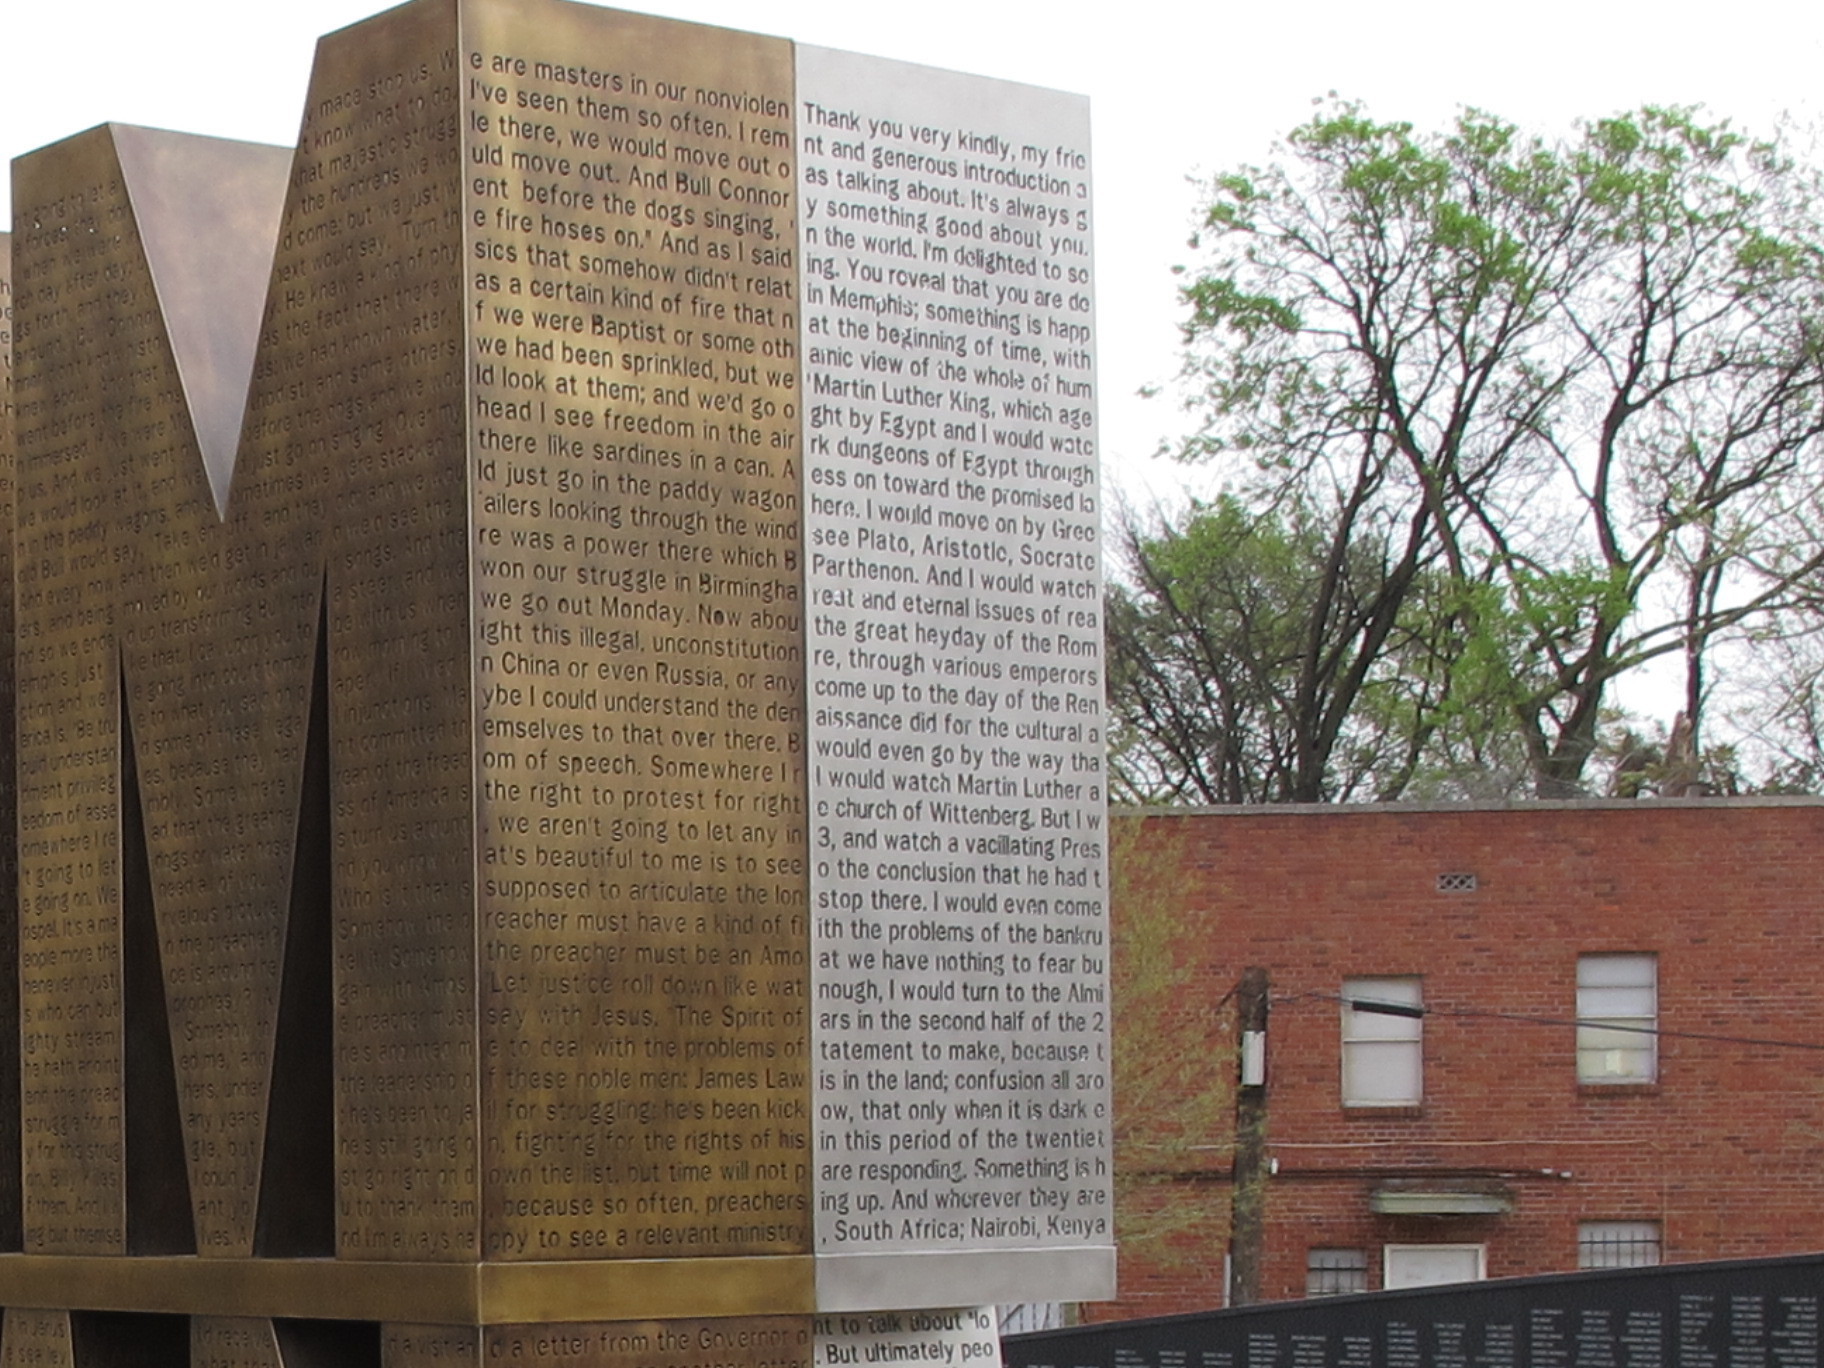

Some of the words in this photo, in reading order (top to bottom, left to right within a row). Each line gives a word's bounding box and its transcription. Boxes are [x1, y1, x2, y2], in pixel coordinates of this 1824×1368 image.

[491, 54, 527, 77] are
[534, 61, 624, 92] masters
[630, 72, 648, 96] in
[655, 81, 688, 102] our
[694, 88, 789, 119] nonviolen
[802, 101, 861, 132] Thank
[868, 118, 903, 140] you
[909, 125, 952, 153] very
[957, 128, 1016, 162] kindly,
[1021, 144, 1049, 169] my
[511, 151, 571, 177] move
[578, 162, 621, 184] out.
[628, 164, 668, 190] And
[675, 171, 711, 197] Bull
[718, 177, 790, 209] Connor
[476, 335, 508, 358] we
[515, 334, 554, 362] had
[561, 340, 614, 369] been
[621, 352, 719, 384] sprinkled,
[725, 360, 759, 386] but
[766, 370, 795, 390] we
[808, 315, 830, 336] at
[837, 317, 869, 341] the
[876, 321, 968, 358] beginning
[974, 335, 994, 357] of
[1001, 340, 1047, 368] time,
[1053, 348, 1091, 371] with
[476, 394, 532, 422] head
[540, 400, 546, 424] I
[554, 407, 594, 429] see
[603, 407, 695, 439] freedom
[703, 418, 720, 442] in
[728, 422, 762, 447] the
[770, 428, 796, 450] air
[504, 461, 549, 488] just
[557, 468, 585, 494] go
[592, 469, 609, 493] in
[617, 472, 651, 497] the
[659, 479, 723, 509] paddy
[730, 488, 797, 513] wagon
[479, 559, 525, 580] won
[532, 563, 568, 583] our
[576, 565, 667, 594] struggle
[674, 570, 692, 593] in
[699, 572, 798, 604] Birmingha
[812, 552, 920, 584] Parthenon.
[926, 563, 963, 587] And
[968, 567, 974, 589] I
[980, 573, 1034, 594] would
[1040, 579, 1097, 600] watch
[814, 614, 847, 637] the
[854, 619, 909, 644] great
[915, 621, 987, 654] heyday
[993, 629, 1014, 651] of
[1021, 631, 1052, 654] the
[1057, 633, 1097, 658] Rom
[814, 648, 841, 671] re,
[848, 647, 925, 677] through
[932, 655, 1003, 680] various
[1009, 663, 1098, 687] emperors
[815, 765, 821, 787] I
[828, 768, 885, 790] would
[892, 772, 951, 793] watch
[957, 773, 1018, 797] Martin
[1023, 776, 1083, 800] Luther
[818, 889, 864, 914] stop
[870, 888, 928, 912] there.
[933, 890, 939, 912] I
[944, 892, 998, 914] would
[1003, 897, 1049, 916] even
[1053, 899, 1102, 917] come
[834, 1219, 894, 1242] South
[900, 1218, 965, 1242] Africa;
[971, 1215, 1041, 1240] Nairobi,
[1047, 1214, 1106, 1240] Kenya
